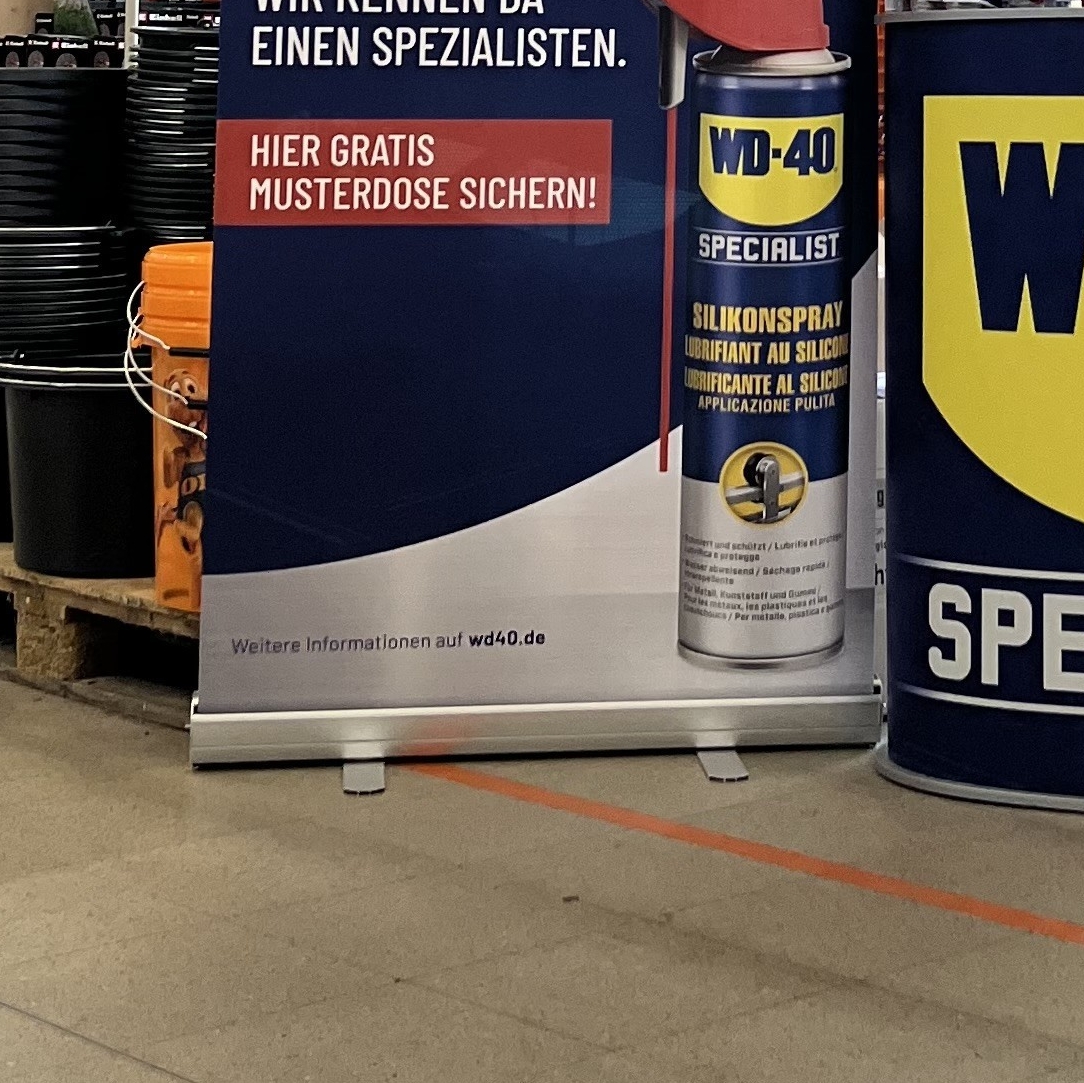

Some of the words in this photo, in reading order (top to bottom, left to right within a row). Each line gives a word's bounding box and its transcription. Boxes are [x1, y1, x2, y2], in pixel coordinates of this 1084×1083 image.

[251, 26, 359, 67] EINEN
[372, 27, 627, 69] SPEZIALISTEN.
[250, 134, 320, 167] HIER
[330, 134, 436, 168] GRATIS
[249, 176, 450, 211] MUSTERDOSE
[459, 176, 597, 209] SICHERN!
[699, 232, 840, 263] SPECIALIST
[692, 299, 844, 334] SILIKONSPRAY
[767, 341, 791, 365] AU
[775, 373, 795, 396] AL
[698, 395, 791, 414] APPLICAZIONE
[795, 392, 836, 412] PULITA
[231, 637, 301, 656] Weitere
[305, 633, 431, 654] Informationen
[435, 632, 465, 649] auf
[469, 629, 546, 648] wd40.de
